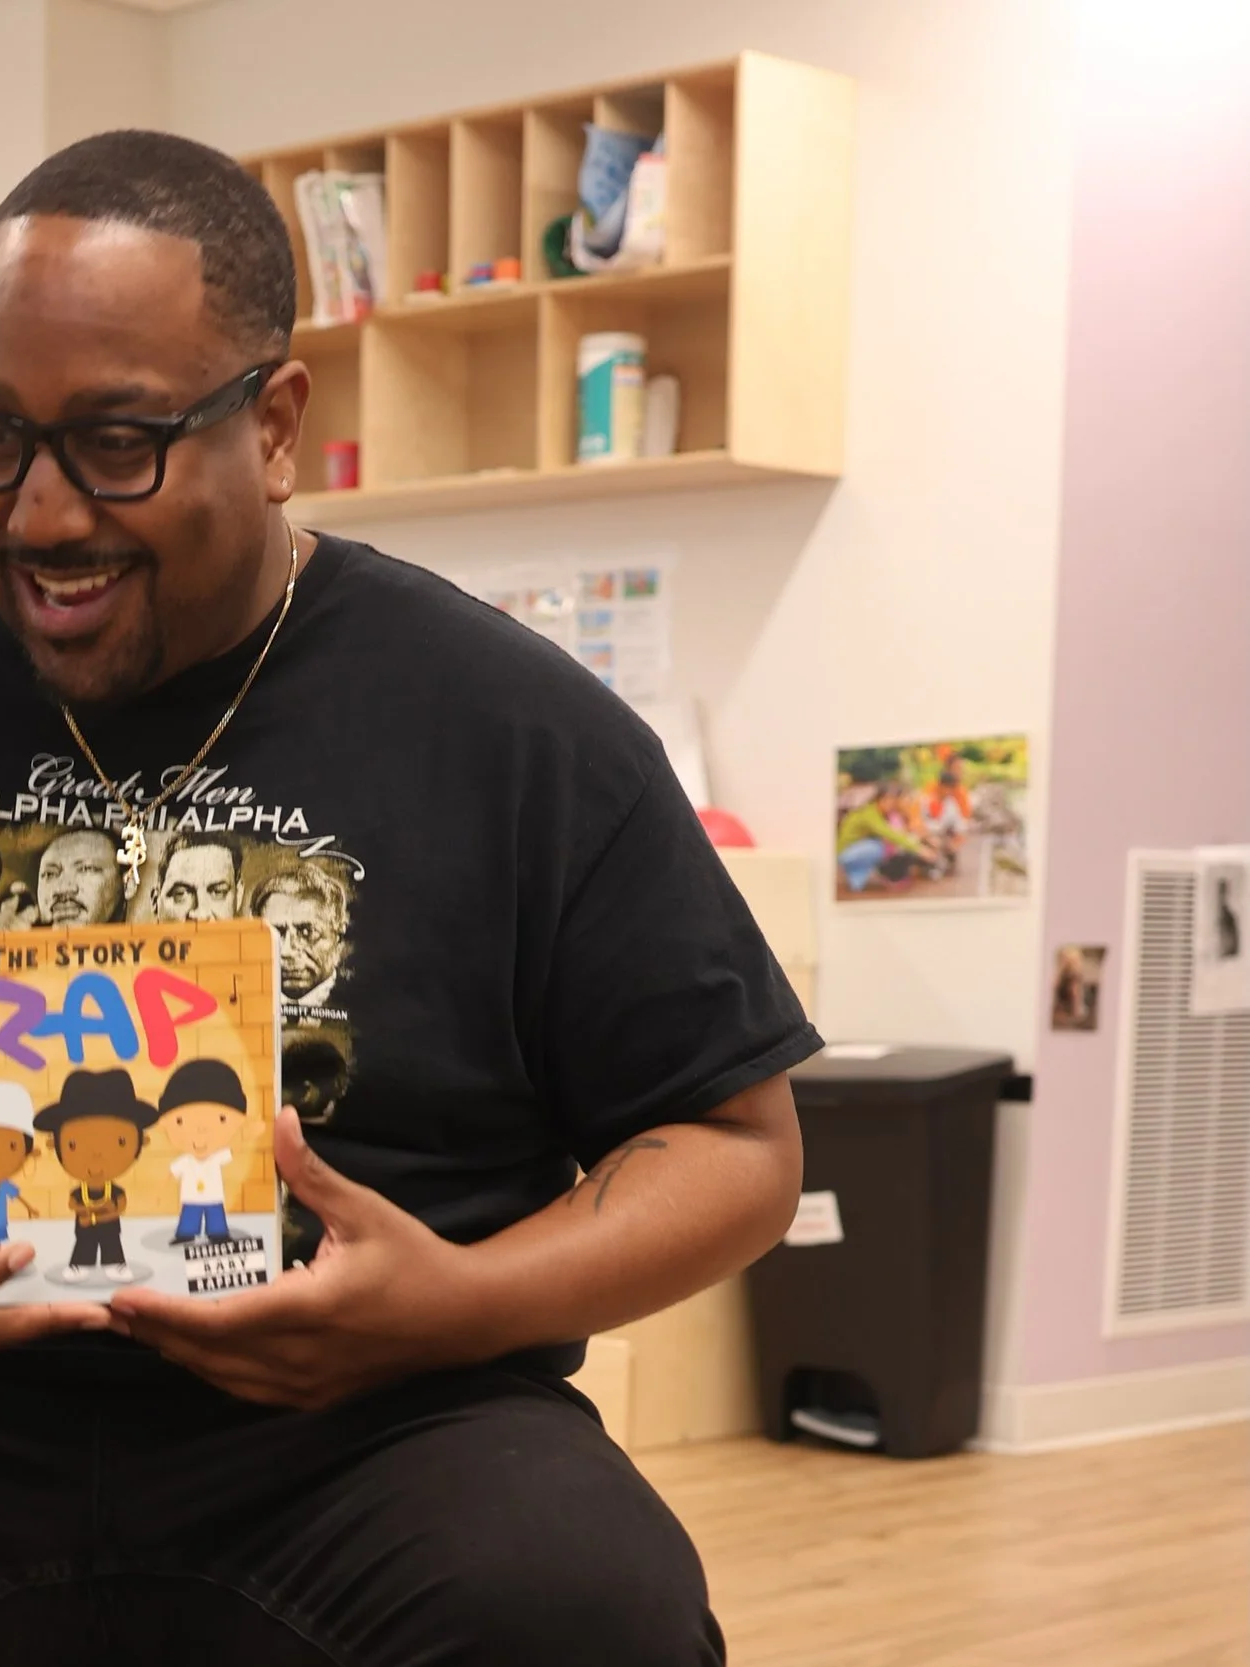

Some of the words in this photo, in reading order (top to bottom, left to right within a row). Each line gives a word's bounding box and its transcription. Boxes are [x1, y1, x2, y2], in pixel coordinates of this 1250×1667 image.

[176, 806, 310, 834] ALPHA
[55, 940, 145, 966] STORY
[158, 937, 191, 962] OF
